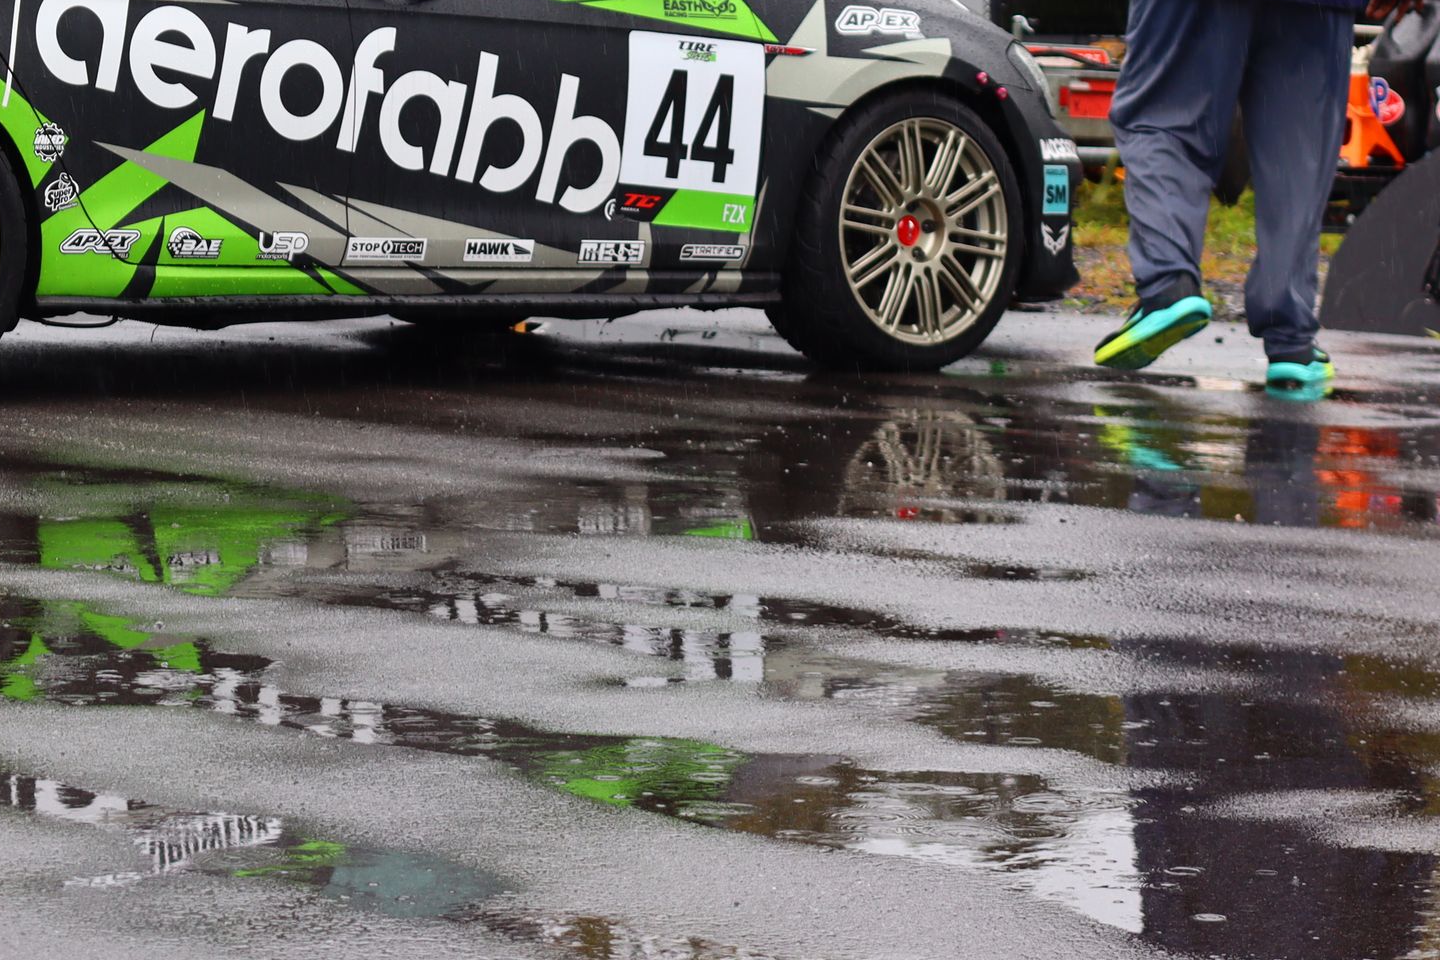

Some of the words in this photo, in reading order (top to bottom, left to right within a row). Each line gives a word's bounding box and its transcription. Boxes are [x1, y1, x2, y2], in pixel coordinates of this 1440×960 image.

[678, 40, 717, 53] TIRE
[643, 69, 735, 184] 44
[1046, 183, 1067, 205] SM
[721, 203, 747, 224] FZX
[466, 242, 511, 255] HAWK
